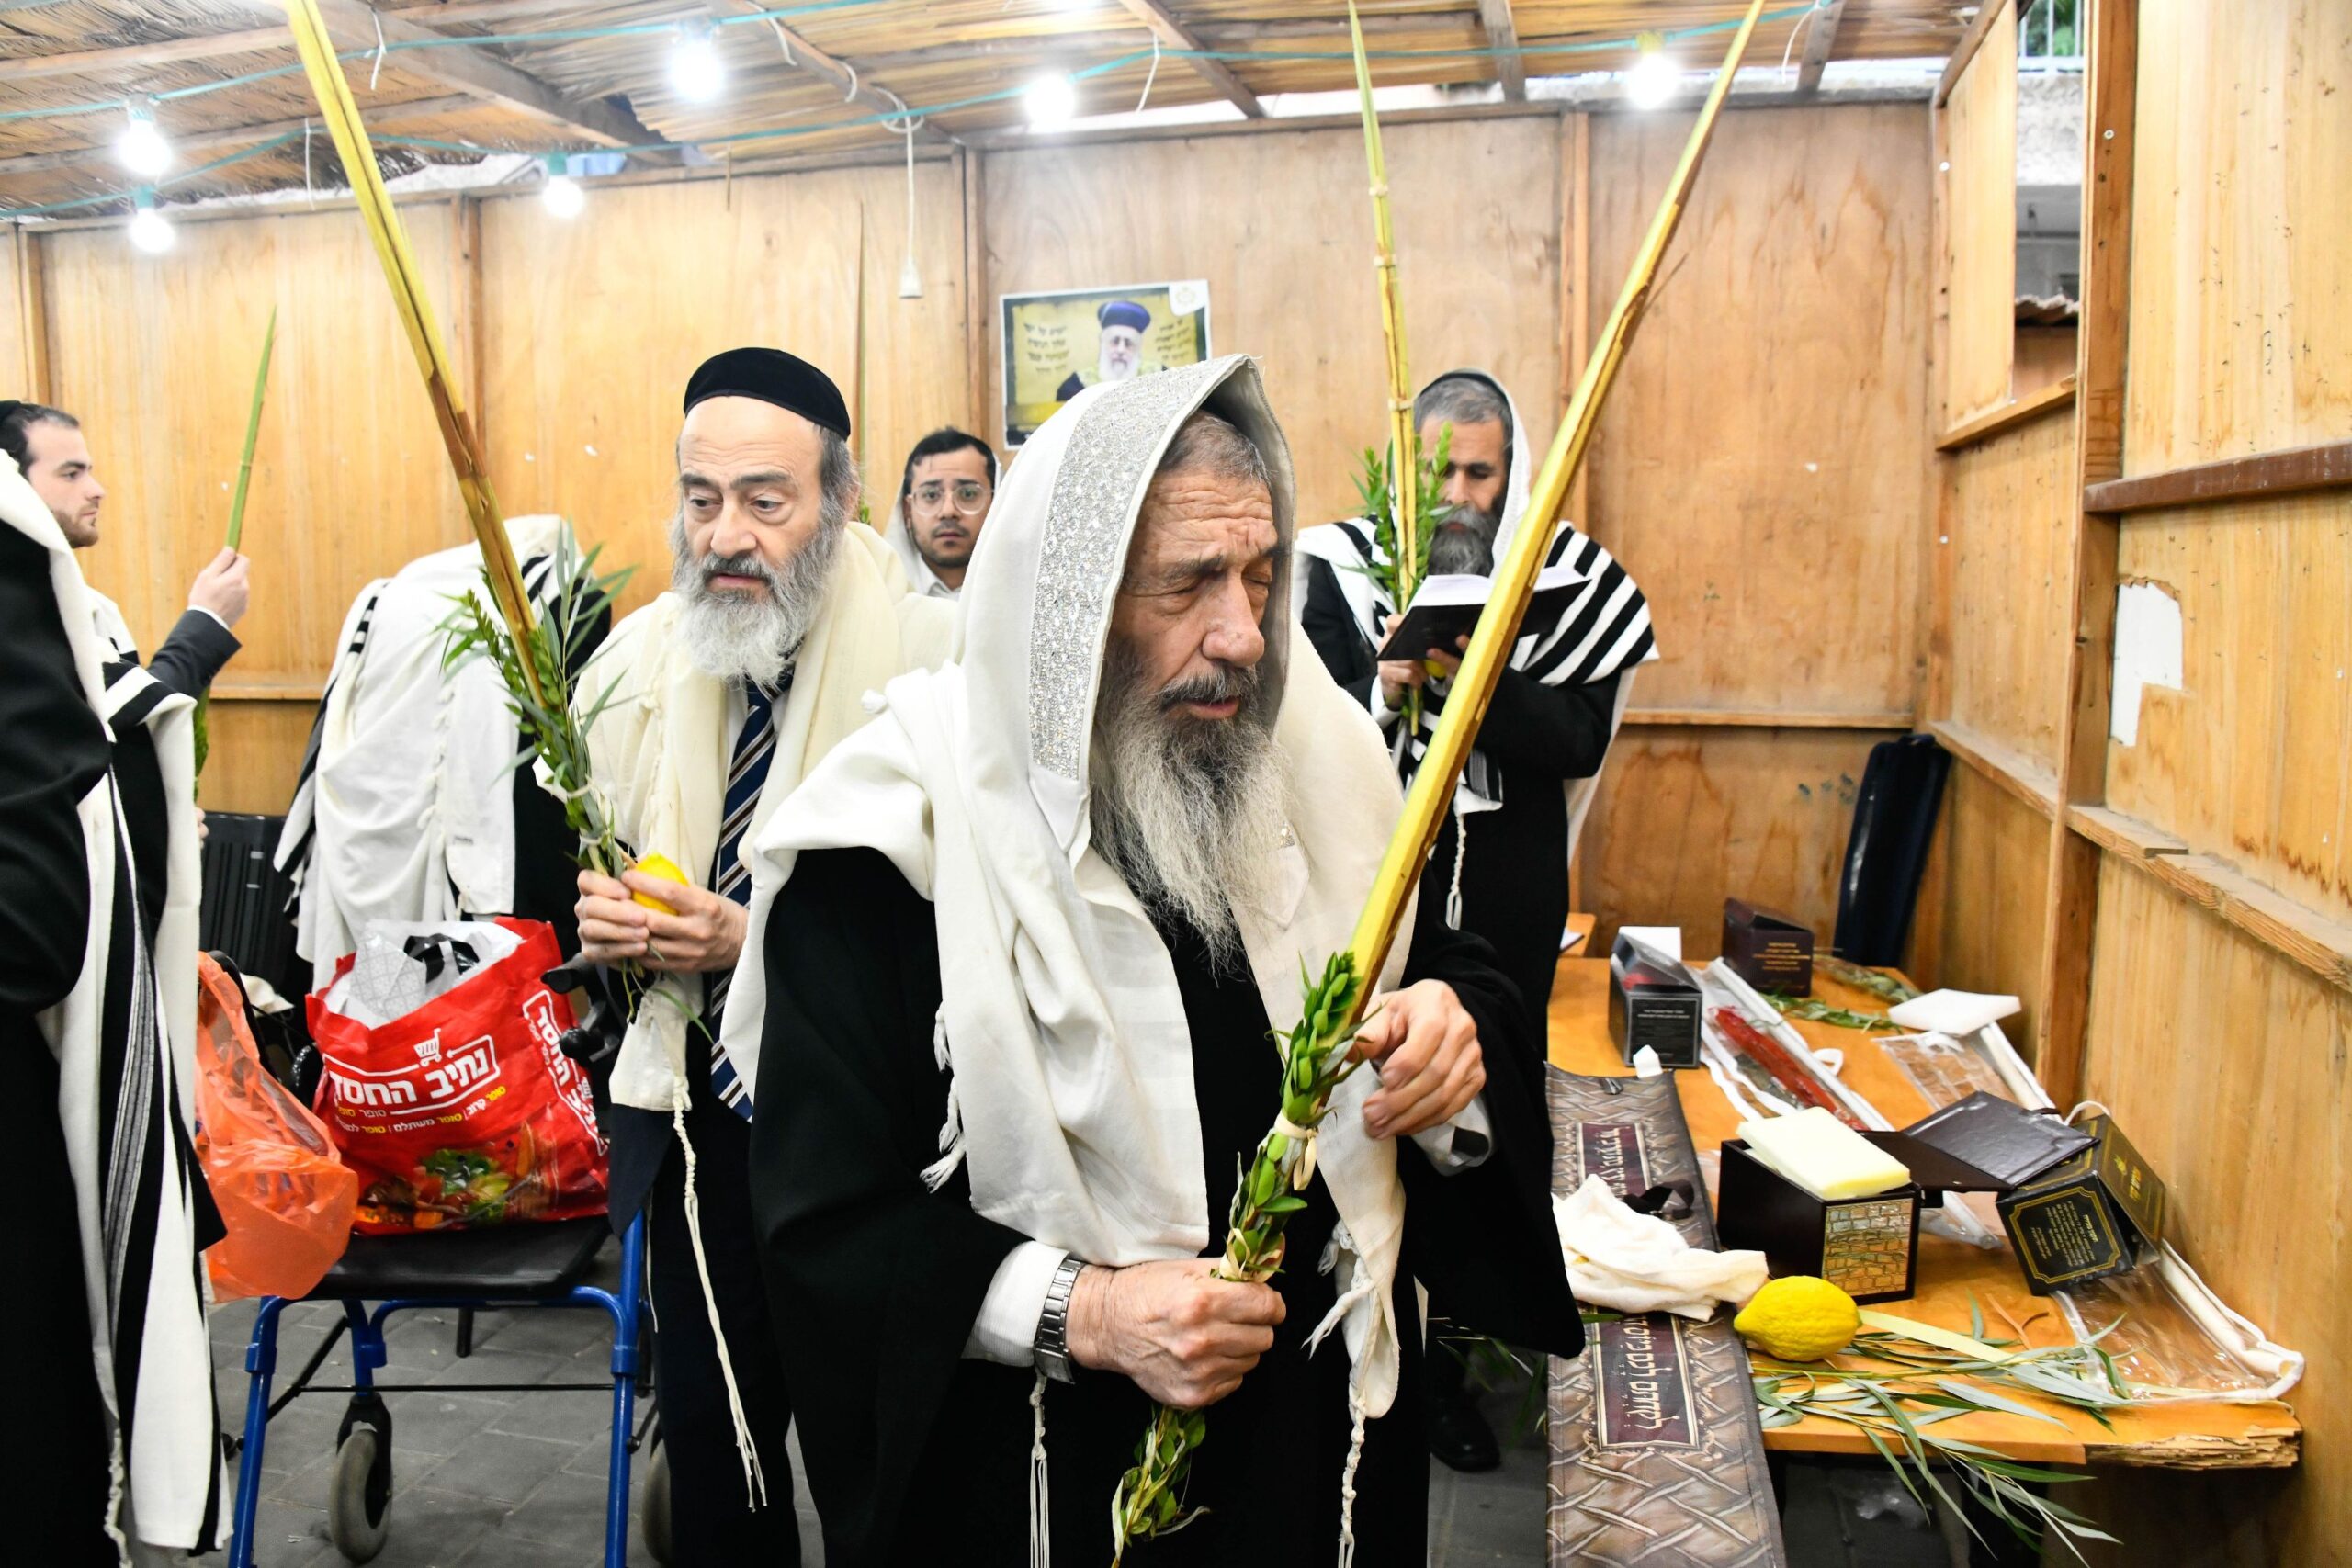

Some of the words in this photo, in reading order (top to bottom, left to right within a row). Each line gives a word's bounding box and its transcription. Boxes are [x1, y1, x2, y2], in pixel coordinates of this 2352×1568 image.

[424, 1048, 489, 1099] נתיב
[329, 1070, 417, 1106] החסד
[485, 1086, 506, 1101] סופר
[359, 1109, 387, 1118] סופר
[436, 1112, 462, 1123] סופר
[360, 1125, 386, 1134] סופר
[393, 1118, 435, 1132] משתלם
